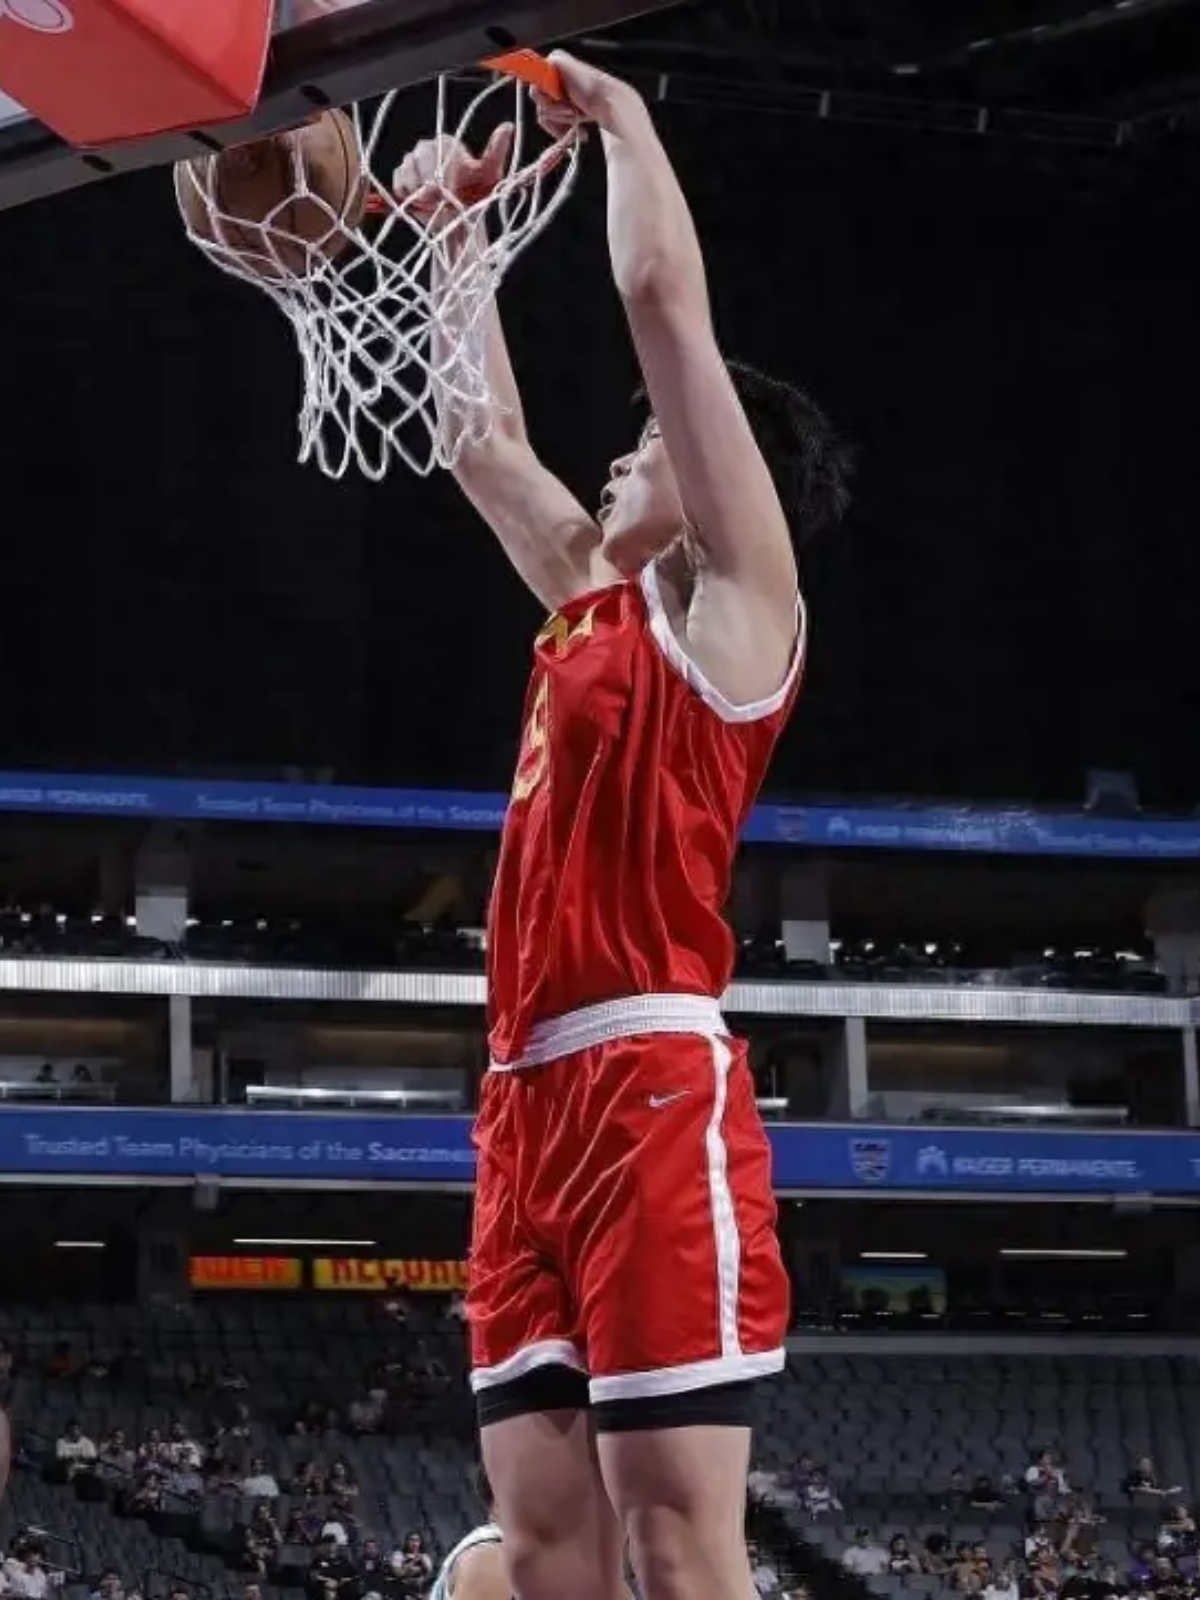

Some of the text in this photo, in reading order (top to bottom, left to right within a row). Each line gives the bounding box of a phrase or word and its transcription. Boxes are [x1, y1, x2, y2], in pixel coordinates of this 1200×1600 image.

[22, 1133, 109, 1156] Trusted
[113, 1134, 174, 1157] Team
[179, 1136, 293, 1163] Physicians
[300, 1140, 321, 1160] of
[326, 1141, 363, 1160] the
